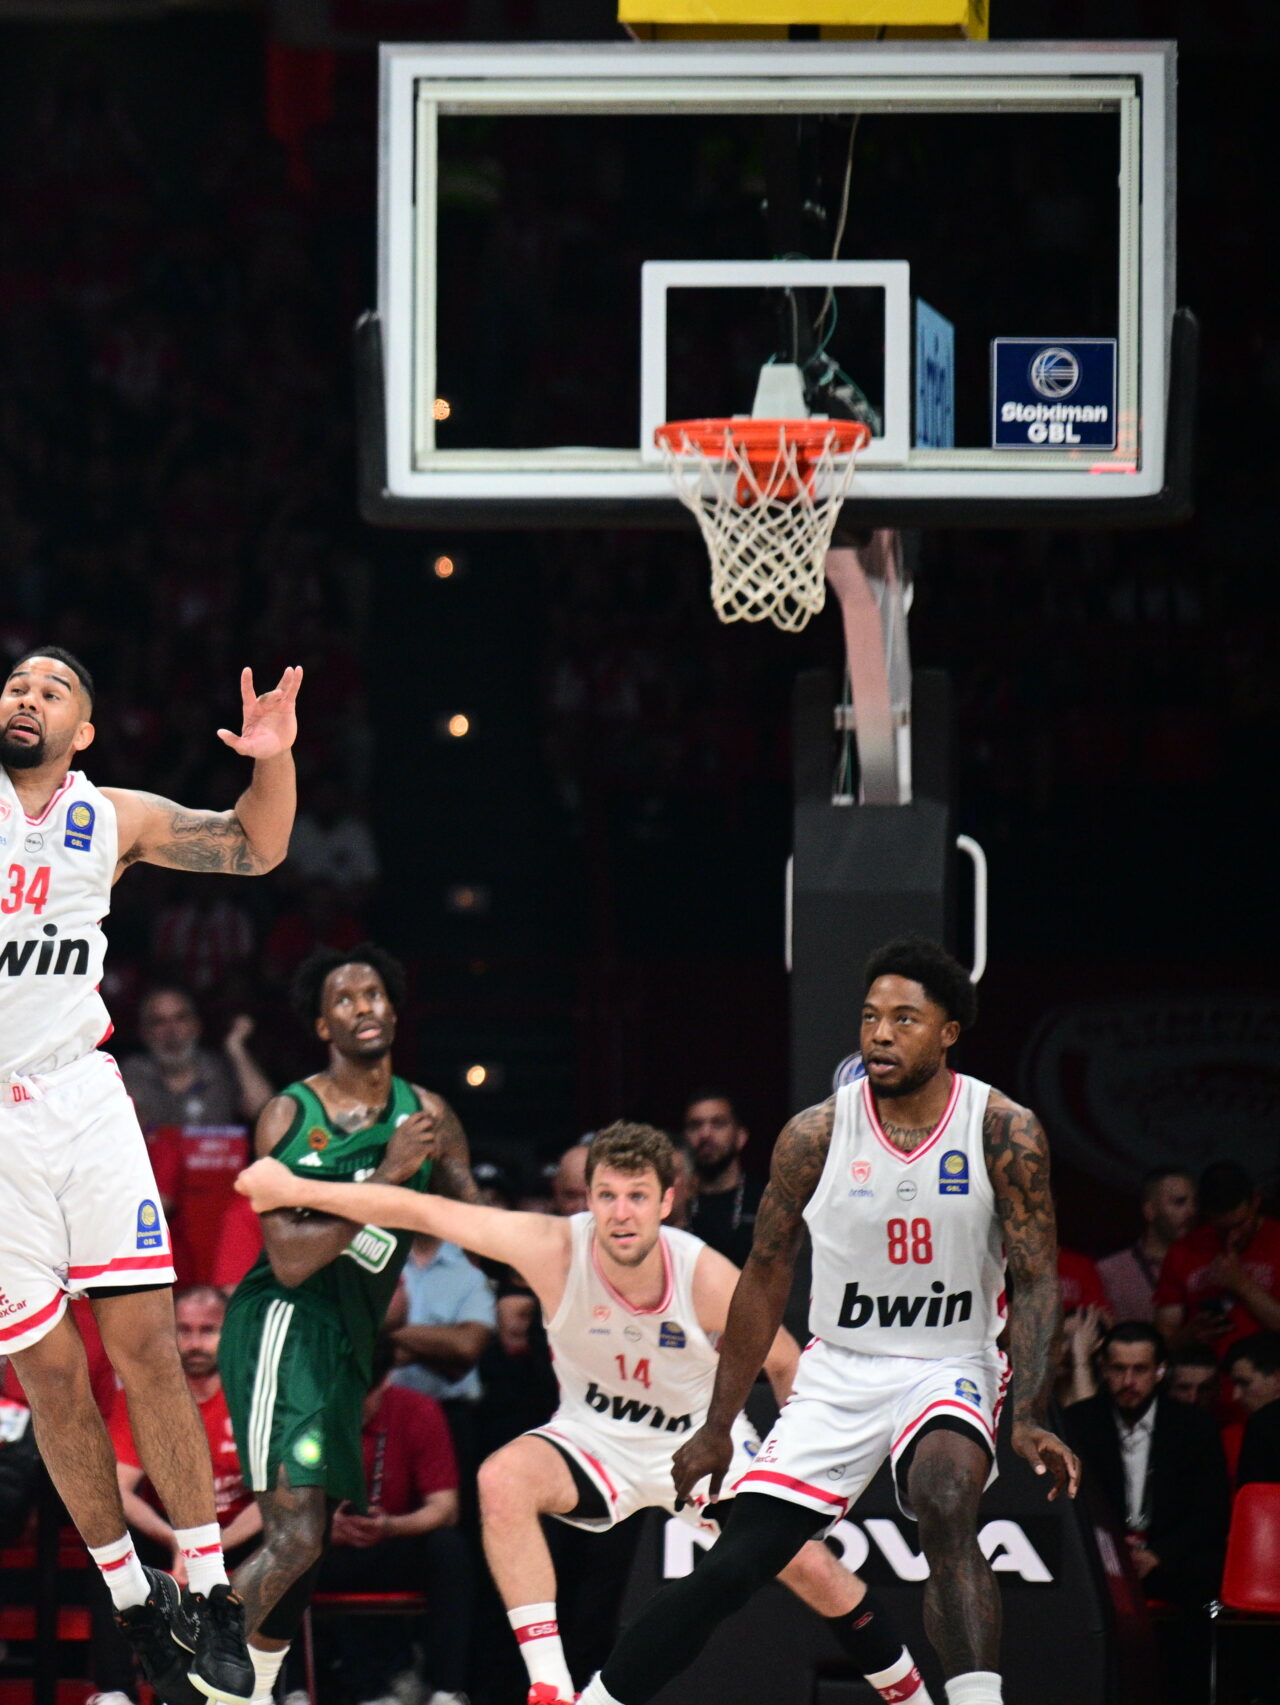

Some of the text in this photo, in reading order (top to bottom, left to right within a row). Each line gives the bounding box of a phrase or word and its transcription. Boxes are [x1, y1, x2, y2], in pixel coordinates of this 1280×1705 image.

[1001, 401, 1108, 422] Stoiximan
[1027, 422, 1081, 444] GBL
[0, 863, 52, 915] 34
[887, 1218, 933, 1265] 88
[837, 1280, 972, 1328] bwin
[615, 1354, 651, 1389] 14
[585, 1382, 692, 1433] bwin
